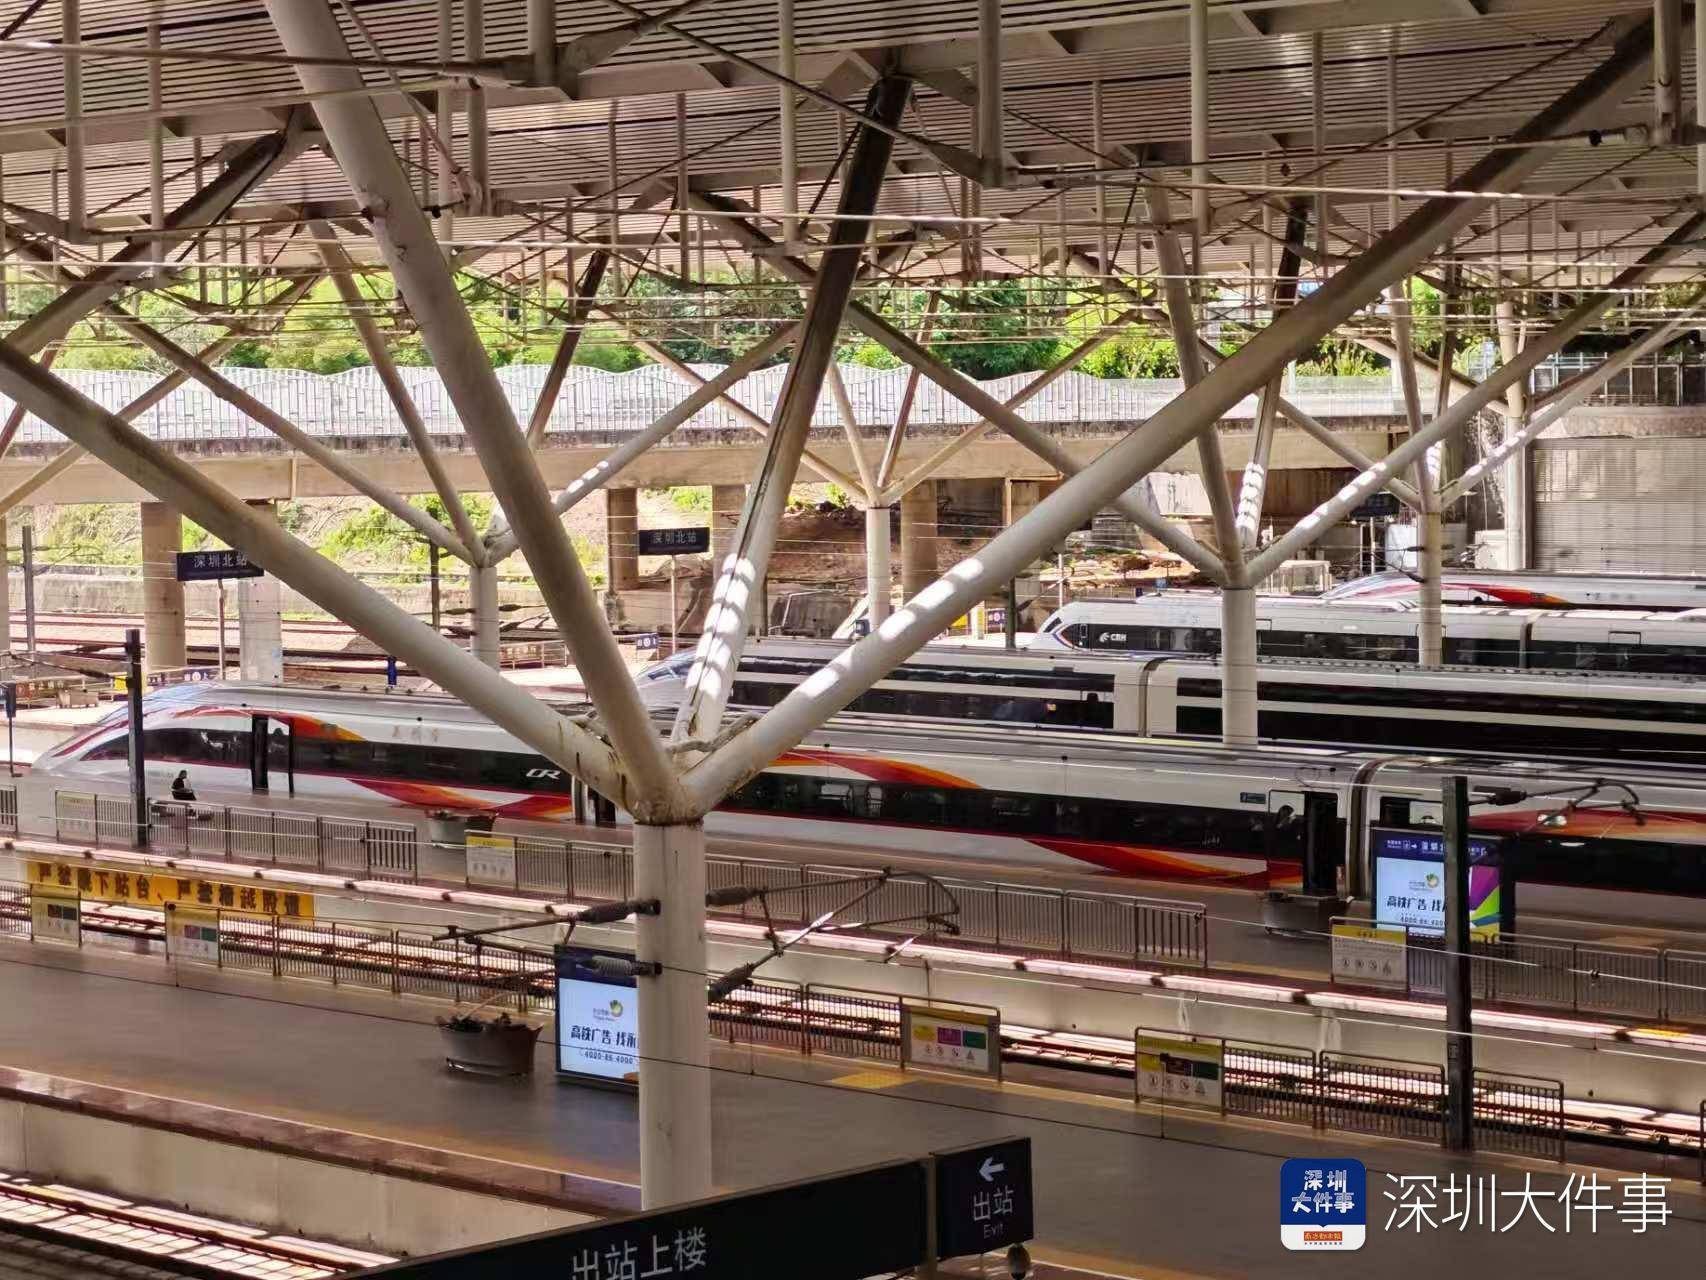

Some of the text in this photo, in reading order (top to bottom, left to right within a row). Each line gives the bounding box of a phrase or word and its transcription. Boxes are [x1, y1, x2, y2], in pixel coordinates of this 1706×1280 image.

[193, 552, 247, 568] 深圳北站
[571, 1025, 612, 1045] 高铁广告
[974, 1185, 1014, 1221] 出站
[572, 1227, 707, 1280] 出站上楼
